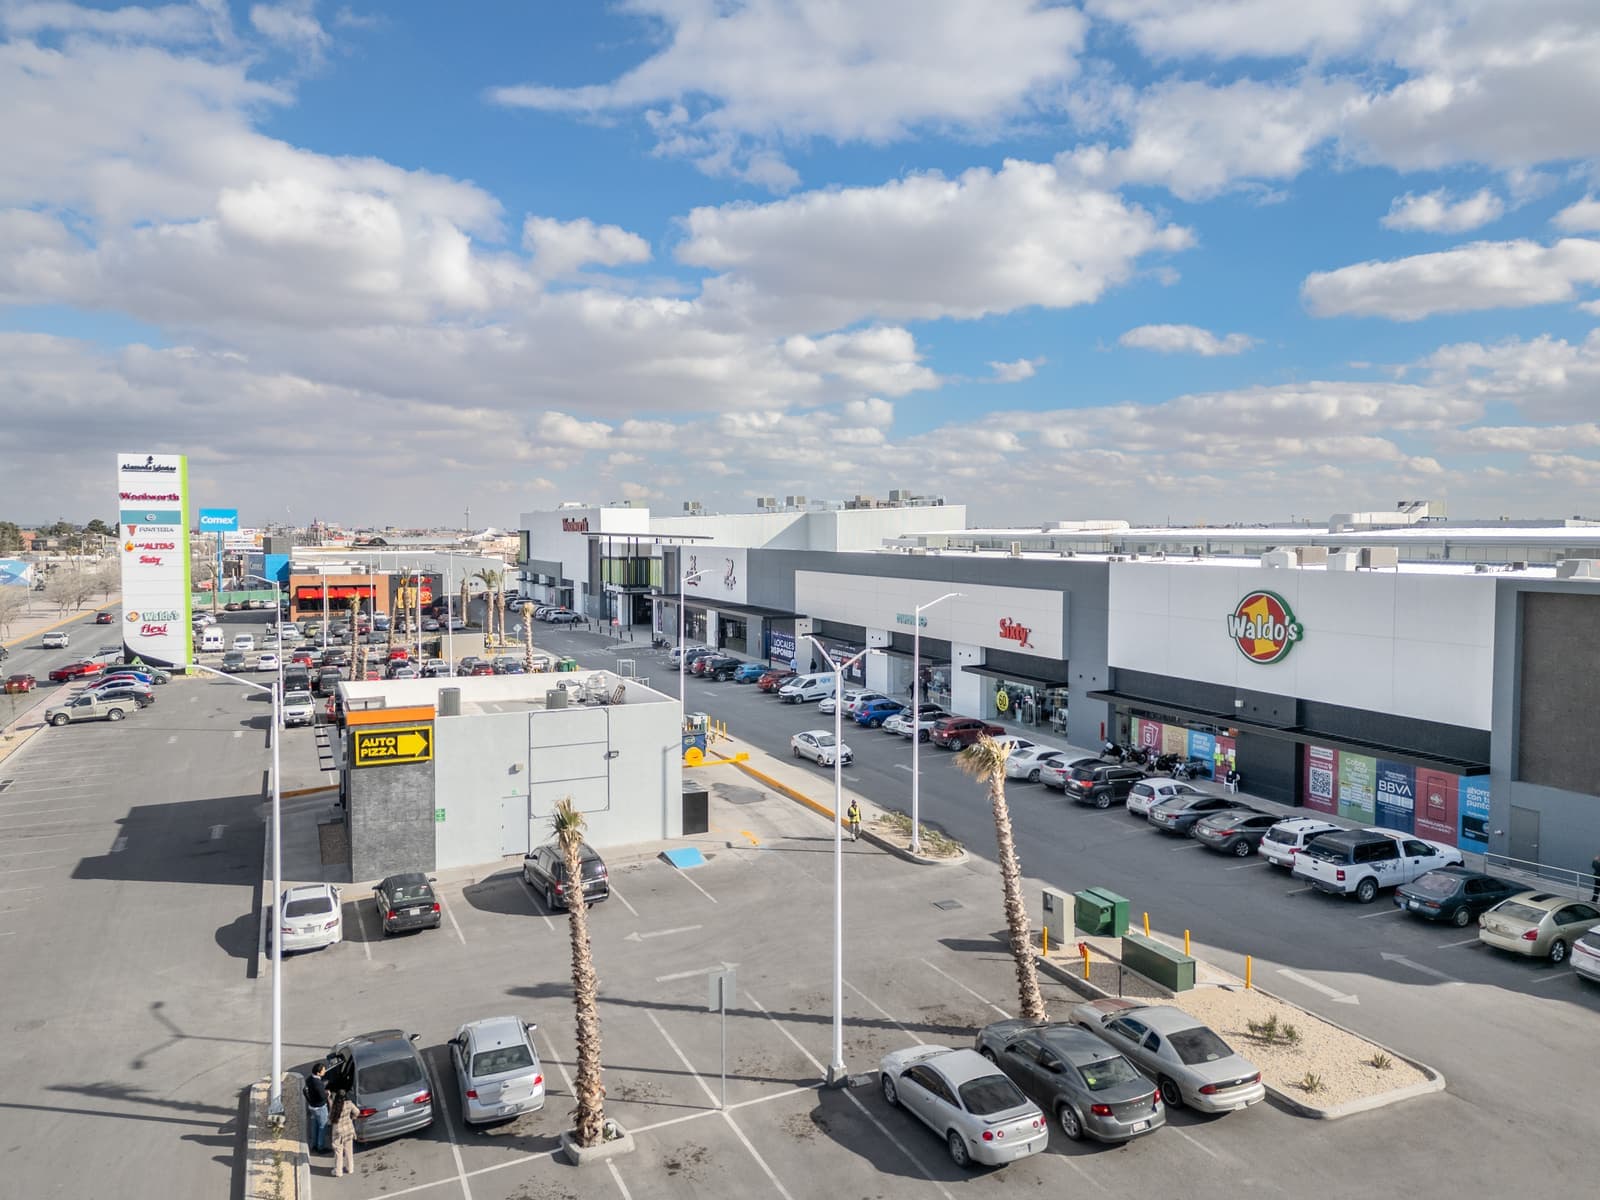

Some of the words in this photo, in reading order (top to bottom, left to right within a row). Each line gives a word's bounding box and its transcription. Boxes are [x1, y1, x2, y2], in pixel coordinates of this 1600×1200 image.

[201, 515, 236, 525] Comex
[1000, 616, 1032, 648] Sixty
[1227, 614, 1299, 641] Waldo's
[773, 639, 795, 651] LOCALES
[361, 737, 396, 748] AUTO
[360, 746, 397, 757] PIZZA
[1379, 780, 1412, 797] BBVA
